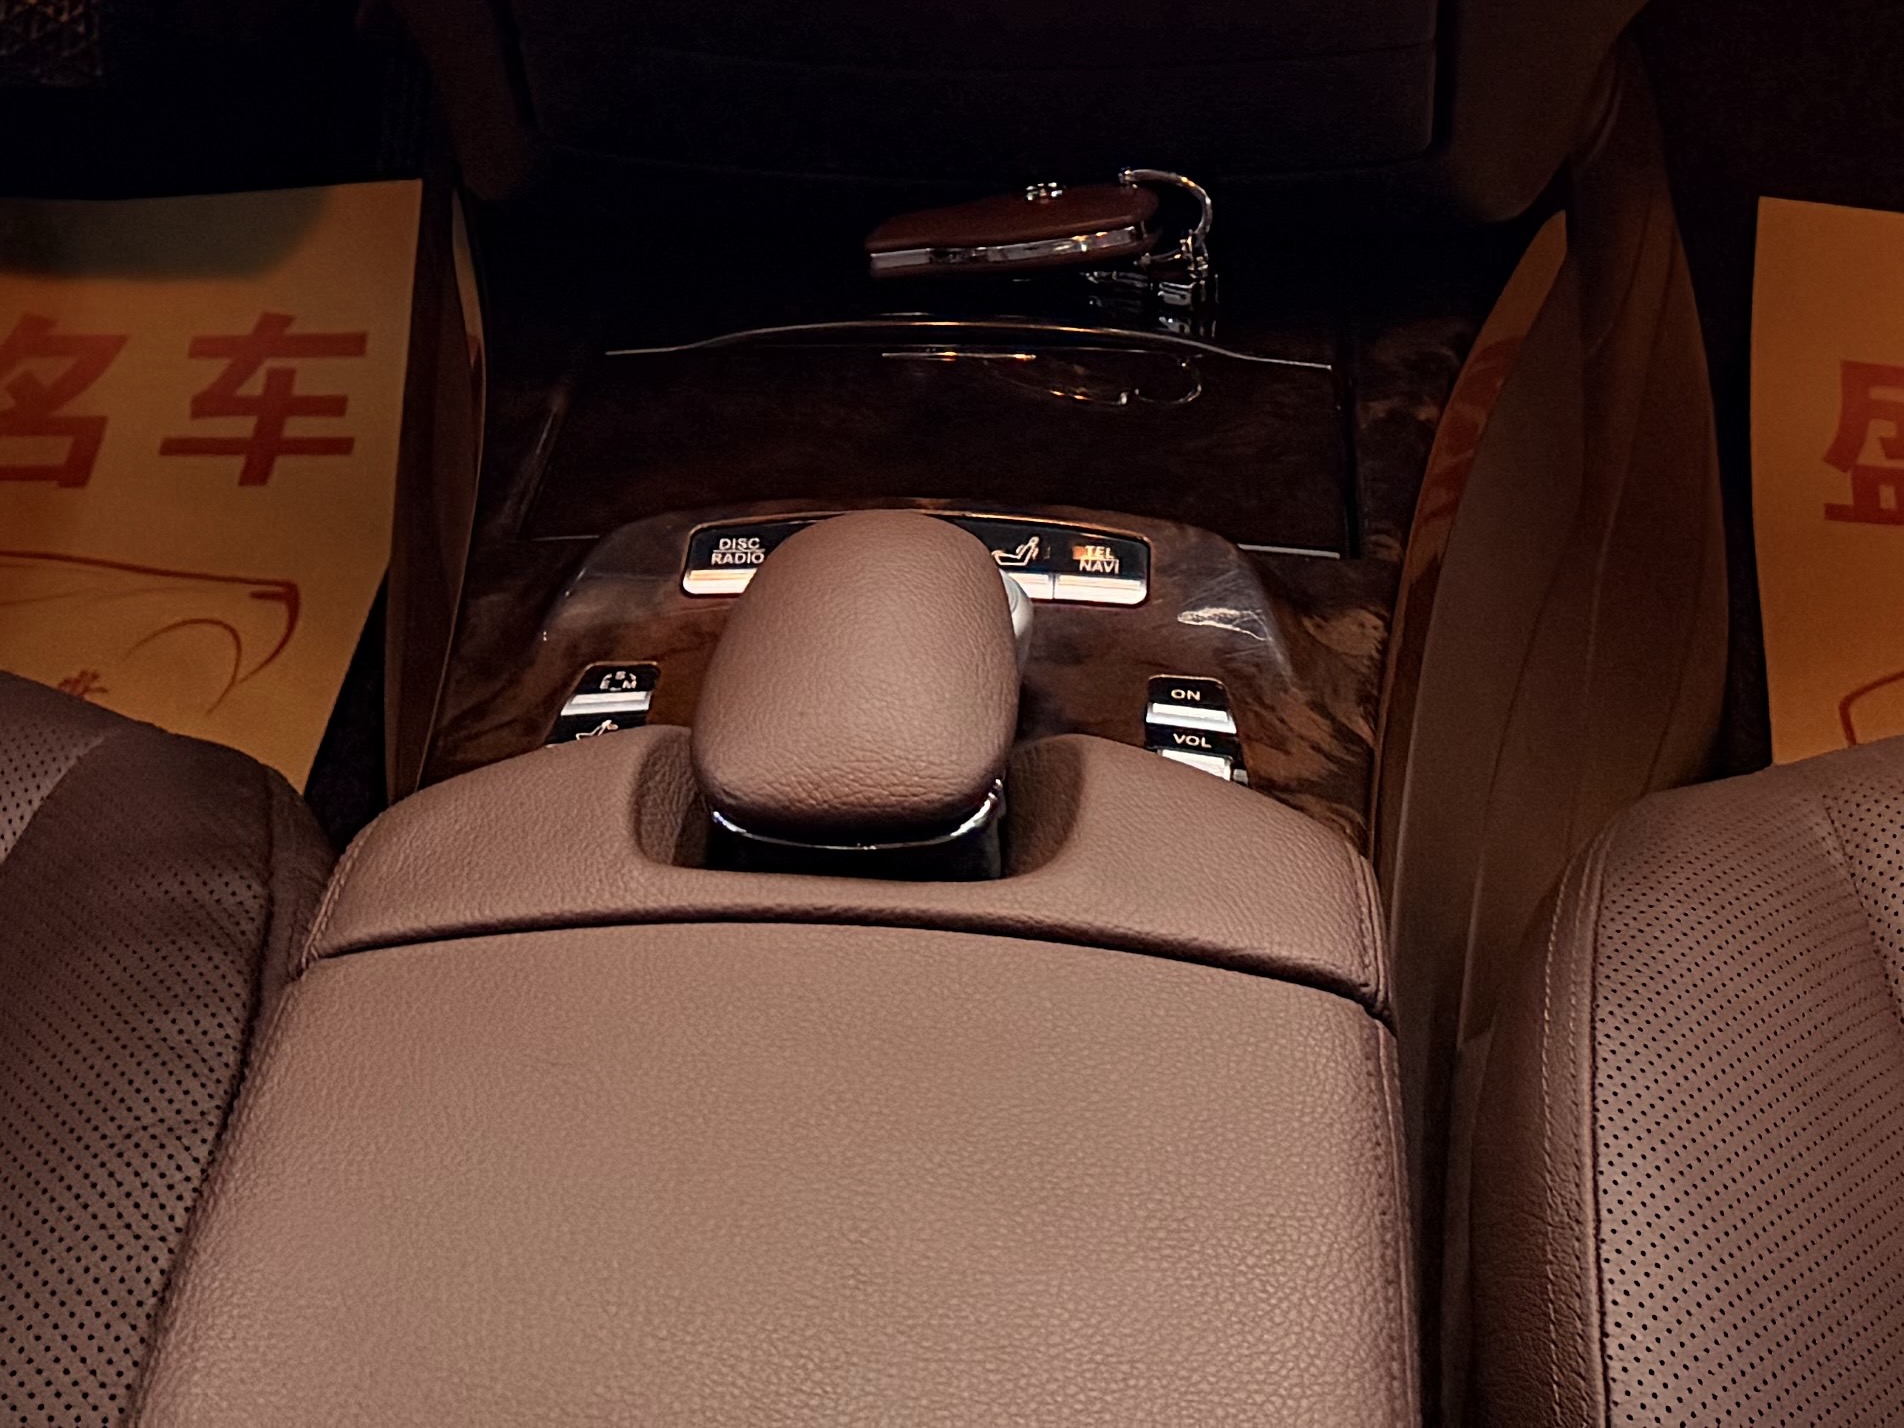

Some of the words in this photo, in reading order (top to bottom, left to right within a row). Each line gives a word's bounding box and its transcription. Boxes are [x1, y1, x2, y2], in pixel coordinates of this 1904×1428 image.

[719, 537, 761, 550] DISC
[711, 551, 765, 565] RADIO
[1084, 545, 1114, 559] TEL
[1079, 559, 1120, 574] NAVI
[1170, 689, 1201, 701] ON
[1172, 732, 1212, 749] VOL
